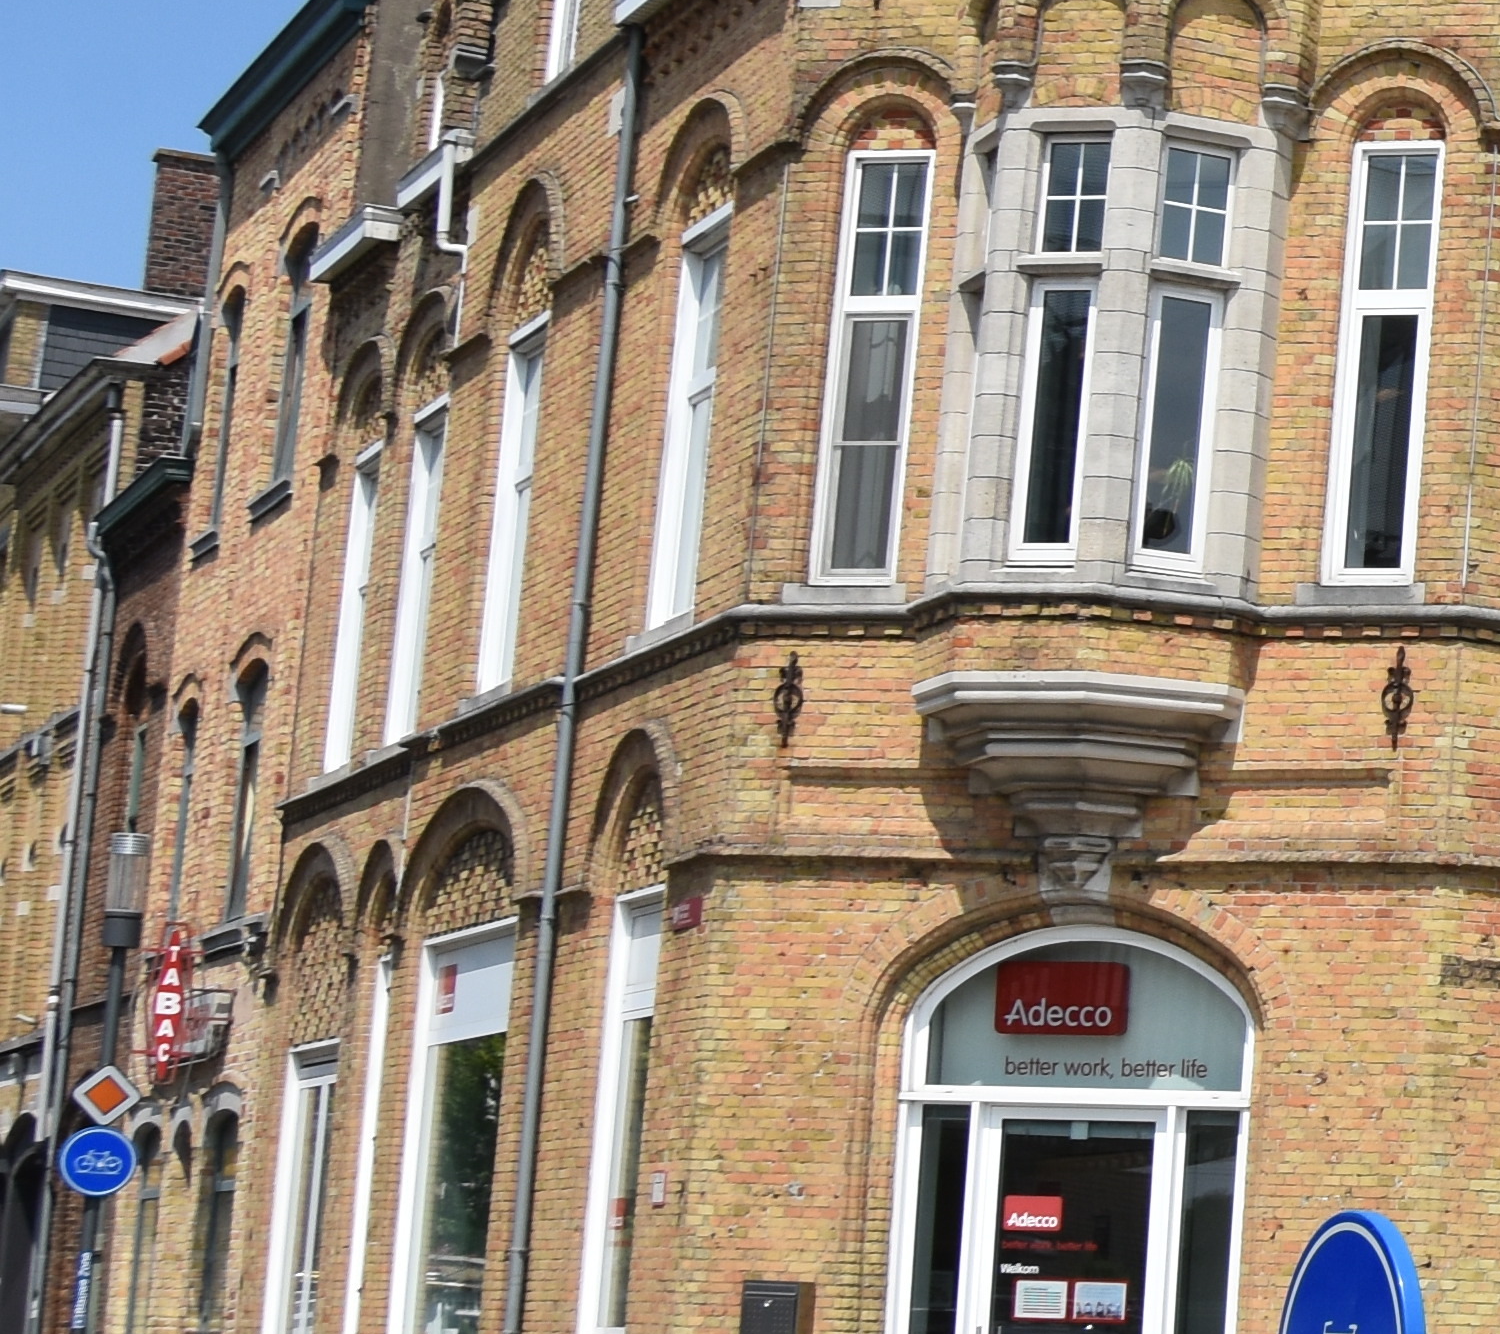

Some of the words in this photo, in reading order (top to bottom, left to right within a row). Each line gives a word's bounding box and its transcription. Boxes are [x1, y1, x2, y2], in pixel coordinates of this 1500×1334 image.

[154, 945, 182, 1062] TABAC
[1004, 998, 1112, 1027] Adecco
[1004, 1056, 1058, 1076] better
[1063, 1057, 1114, 1079] work,
[1121, 1058, 1176, 1078] better
[1181, 1059, 1208, 1078] life
[1007, 1212, 1058, 1228] Adecco
[1000, 1263, 1039, 1274] Welkom
